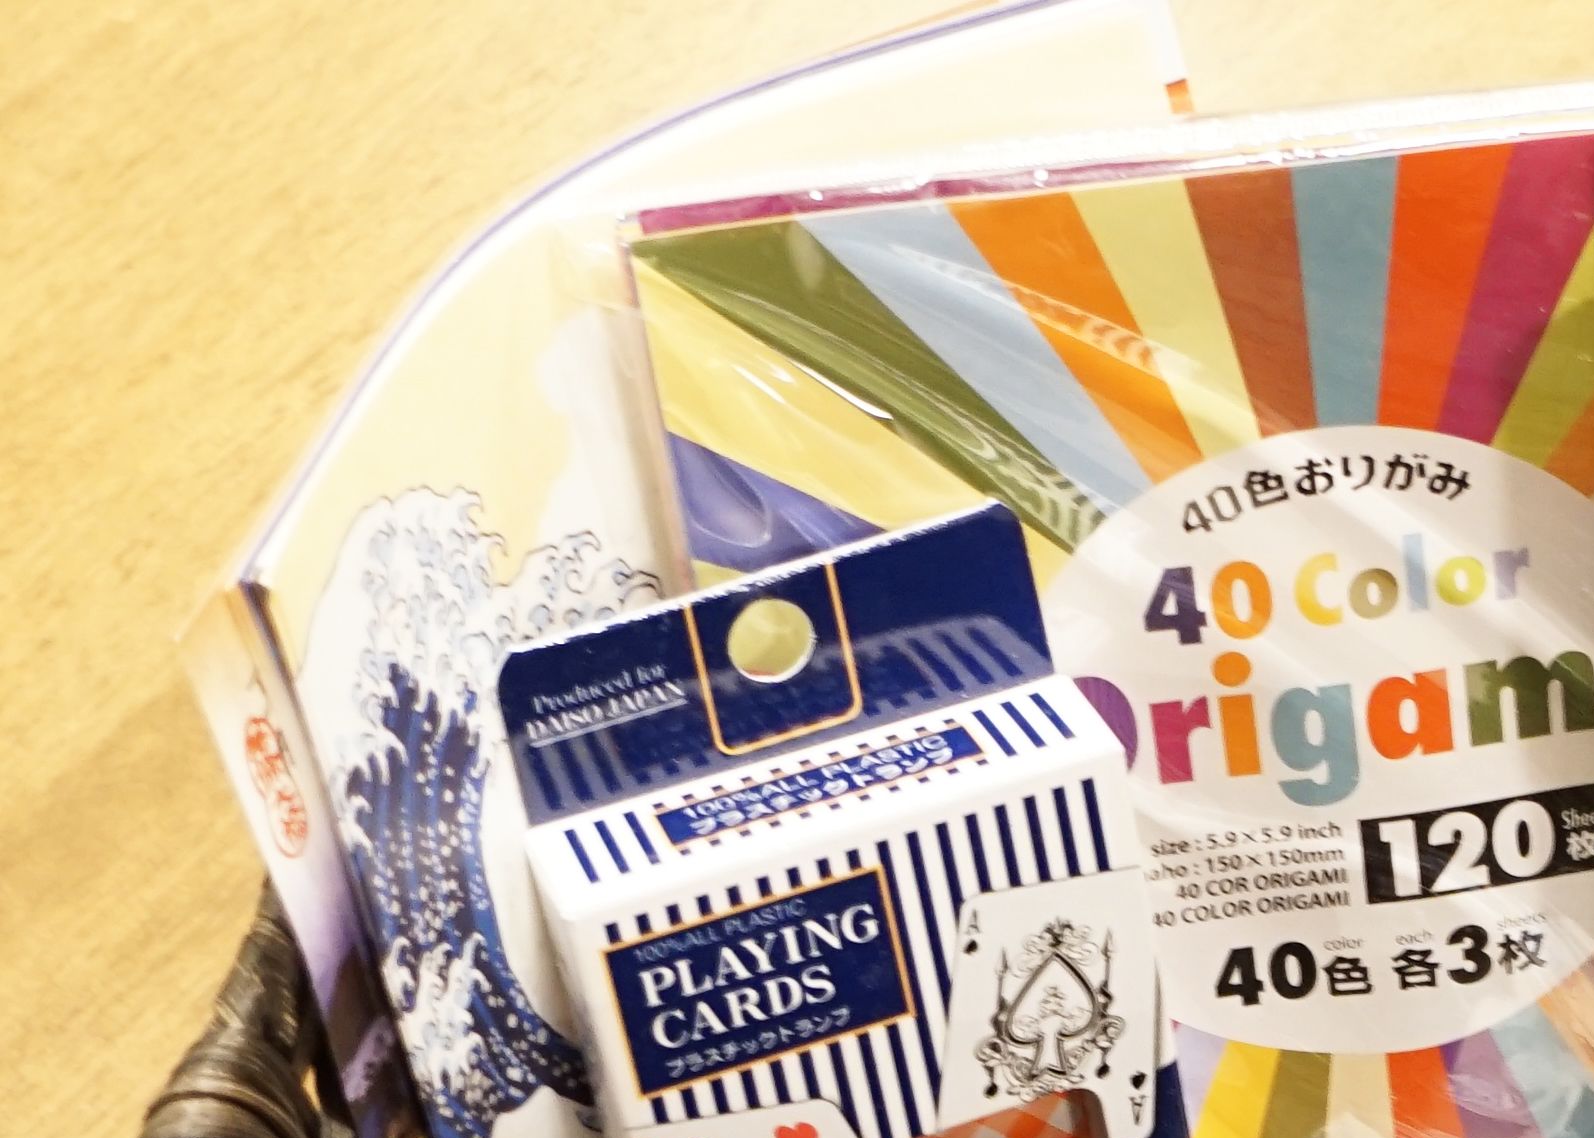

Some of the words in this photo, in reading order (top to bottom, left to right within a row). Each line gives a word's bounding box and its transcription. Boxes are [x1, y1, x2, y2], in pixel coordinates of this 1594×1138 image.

[1181, 452, 1471, 534] 40色おりがみ
[1143, 559, 1273, 646] 40
[1294, 532, 1531, 627] Color
[1150, 839, 1191, 857] size
[1297, 821, 1343, 841] inch
[1377, 799, 1556, 898] 120
[1175, 882, 1201, 900] 40
[1204, 876, 1250, 897] COR
[1253, 867, 1350, 891] ORIGAMI
[1180, 900, 1253, 925] COLOR
[1256, 890, 1351, 915] ORIGAMI
[637, 902, 880, 1009] PLAYING
[1215, 940, 1373, 1007] 40色
[1390, 923, 1548, 991] 各3枚
[1323, 935, 1365, 952] color
[651, 963, 837, 1050] CARDS
[664, 1004, 851, 1079] プラスチックトランプ
